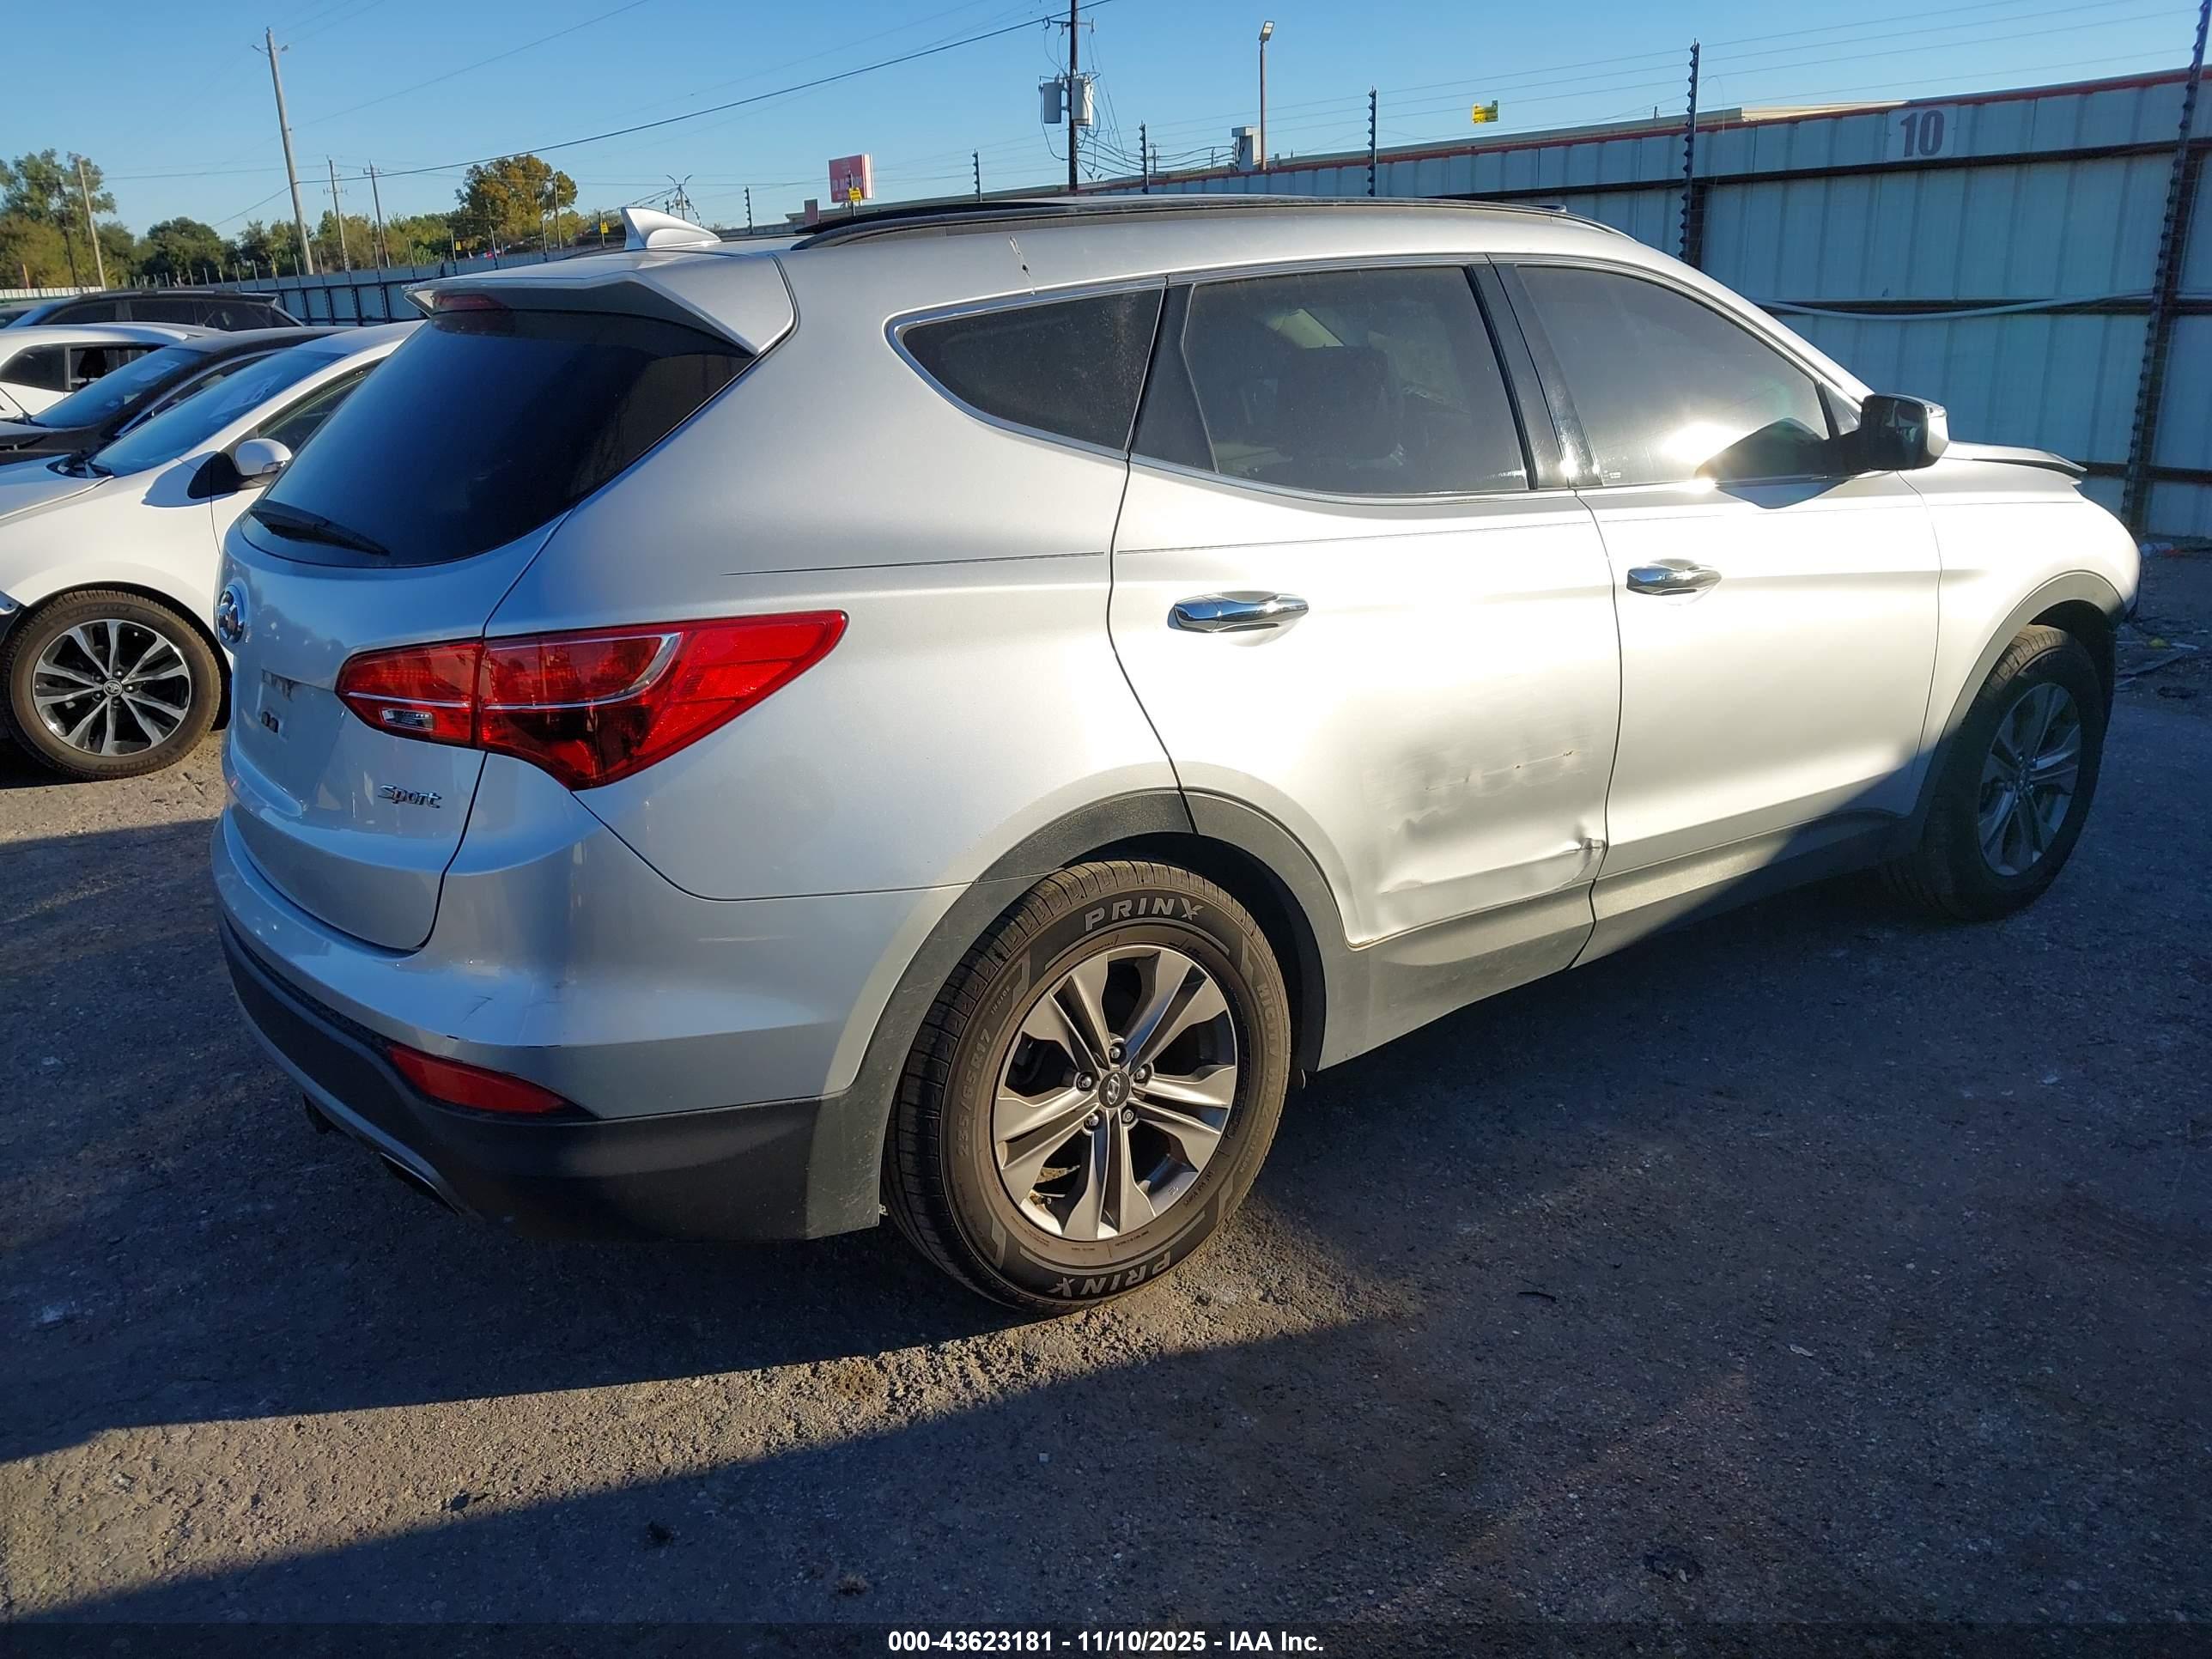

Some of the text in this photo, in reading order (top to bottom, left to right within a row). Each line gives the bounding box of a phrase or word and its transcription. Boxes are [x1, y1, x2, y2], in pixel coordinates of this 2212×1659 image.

[1900, 109, 1945, 157] 10
[378, 784, 442, 809] Sport
[1085, 896, 1205, 932] PRINX
[1047, 1251, 1171, 1297] PRINX
